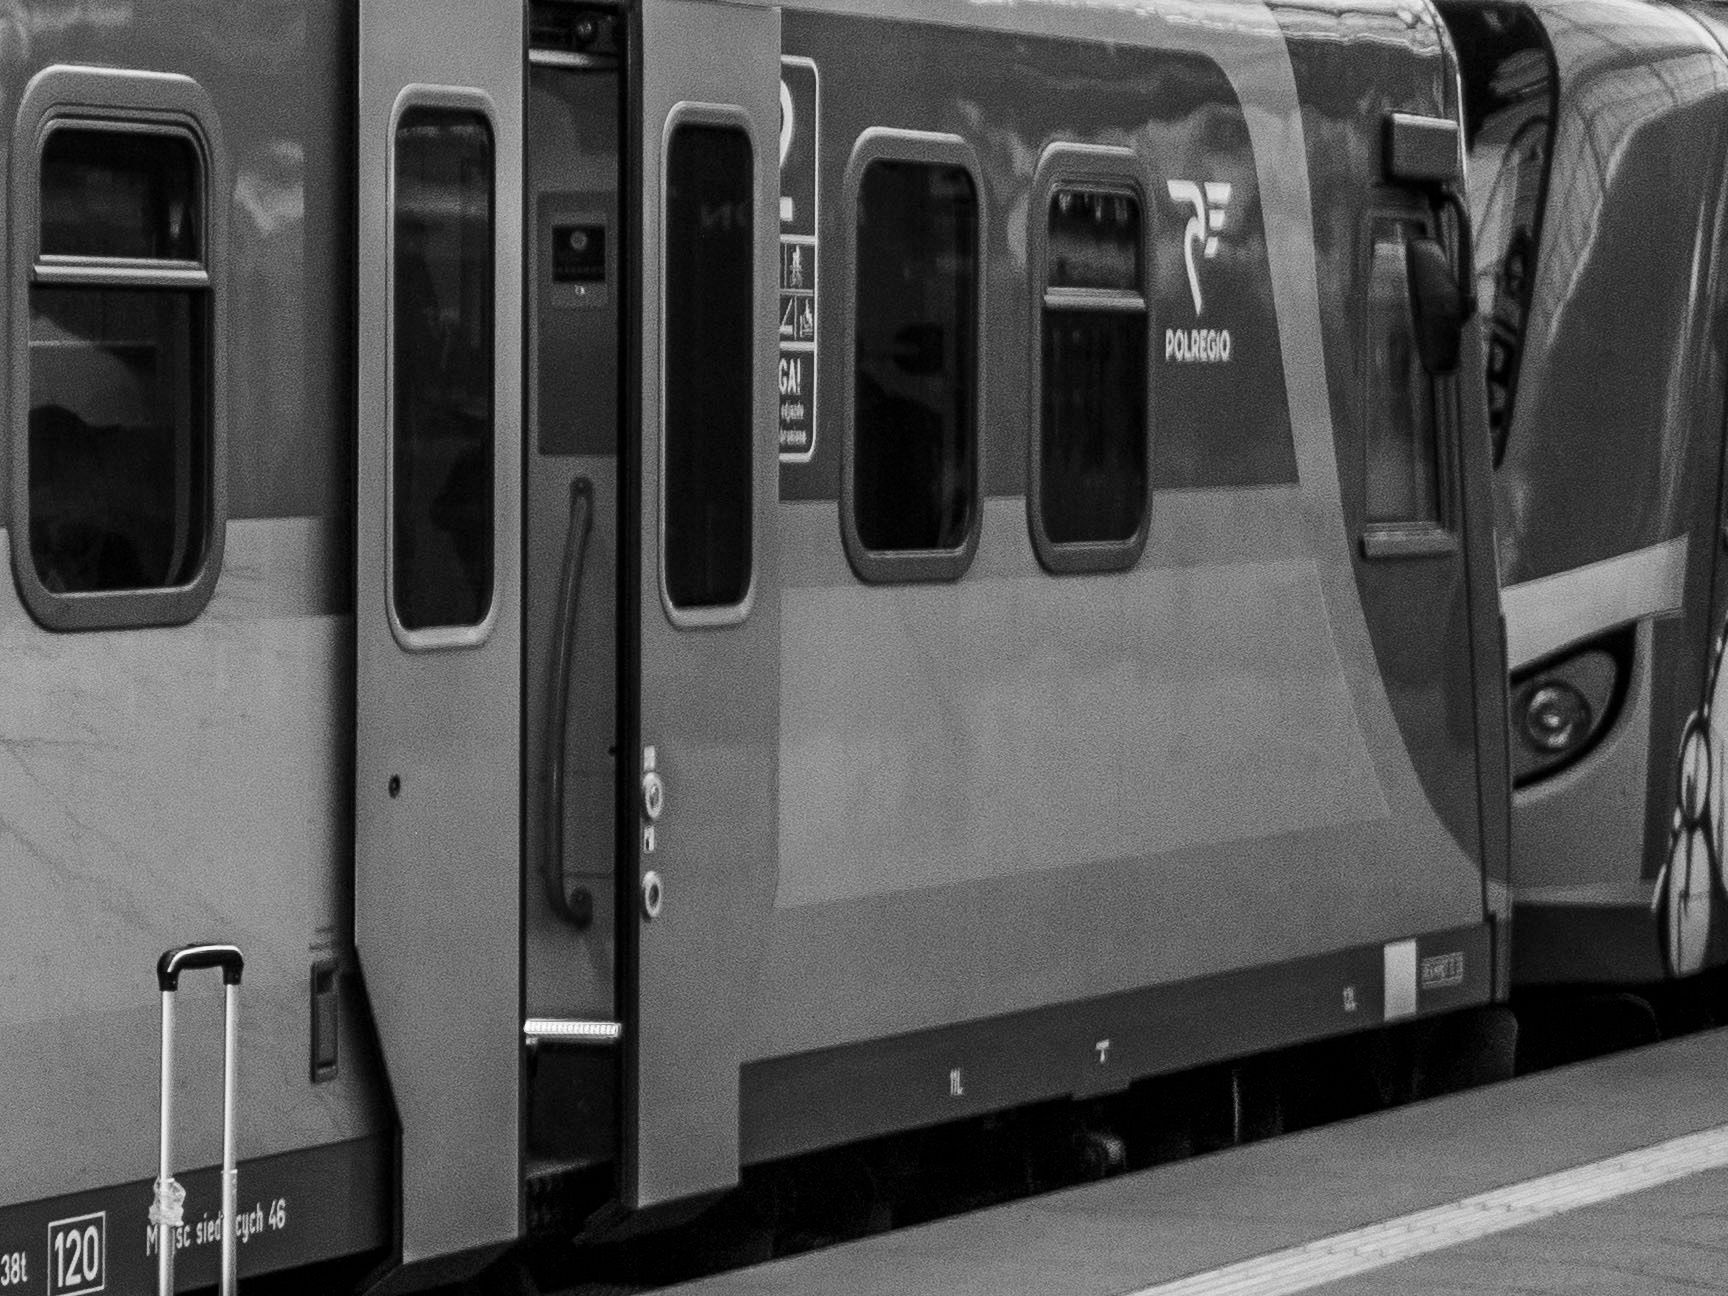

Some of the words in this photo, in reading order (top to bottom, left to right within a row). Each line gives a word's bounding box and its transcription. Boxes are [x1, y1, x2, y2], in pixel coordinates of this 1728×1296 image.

[1165, 328, 1232, 363] POLREGIO
[778, 357, 801, 396] GA!
[146, 1223, 191, 1259] Mjsc
[196, 1202, 264, 1245] siedcych
[268, 1197, 286, 1231] 46
[0, 1251, 28, 1287] 38t
[54, 1225, 99, 1288] 120
